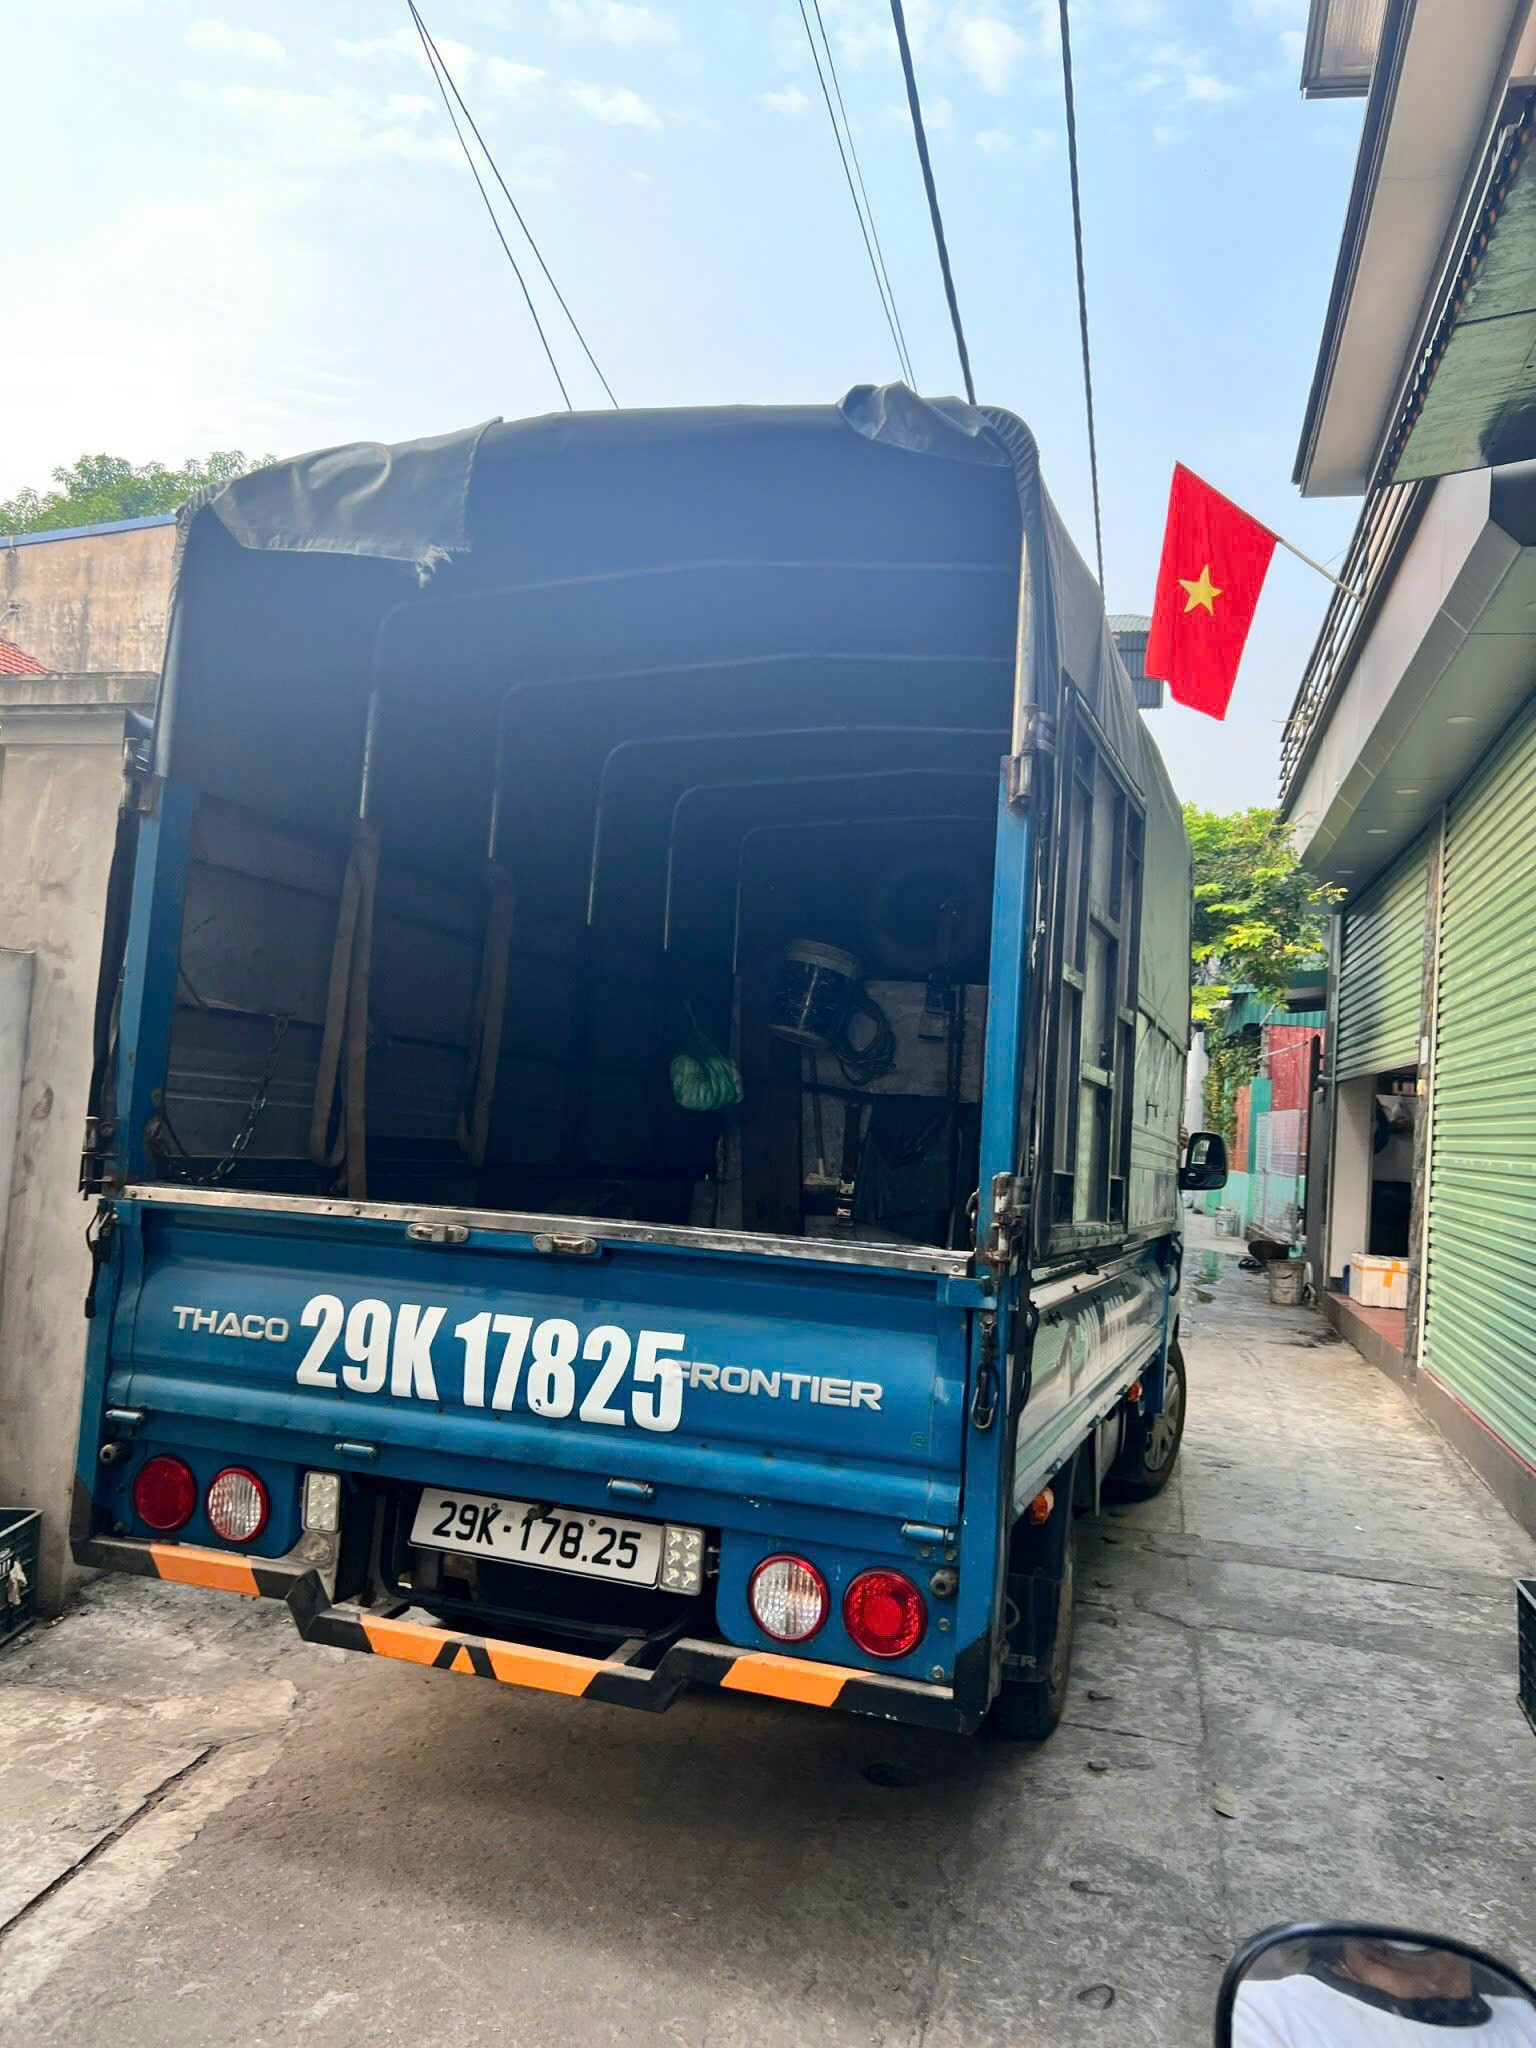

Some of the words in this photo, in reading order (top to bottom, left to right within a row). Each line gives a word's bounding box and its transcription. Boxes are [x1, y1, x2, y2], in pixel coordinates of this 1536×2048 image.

[172, 1305, 289, 1343] THACO
[296, 1294, 448, 1401] 29K
[454, 1311, 686, 1432] 17825
[432, 1500, 642, 1569] 29K-178.25
